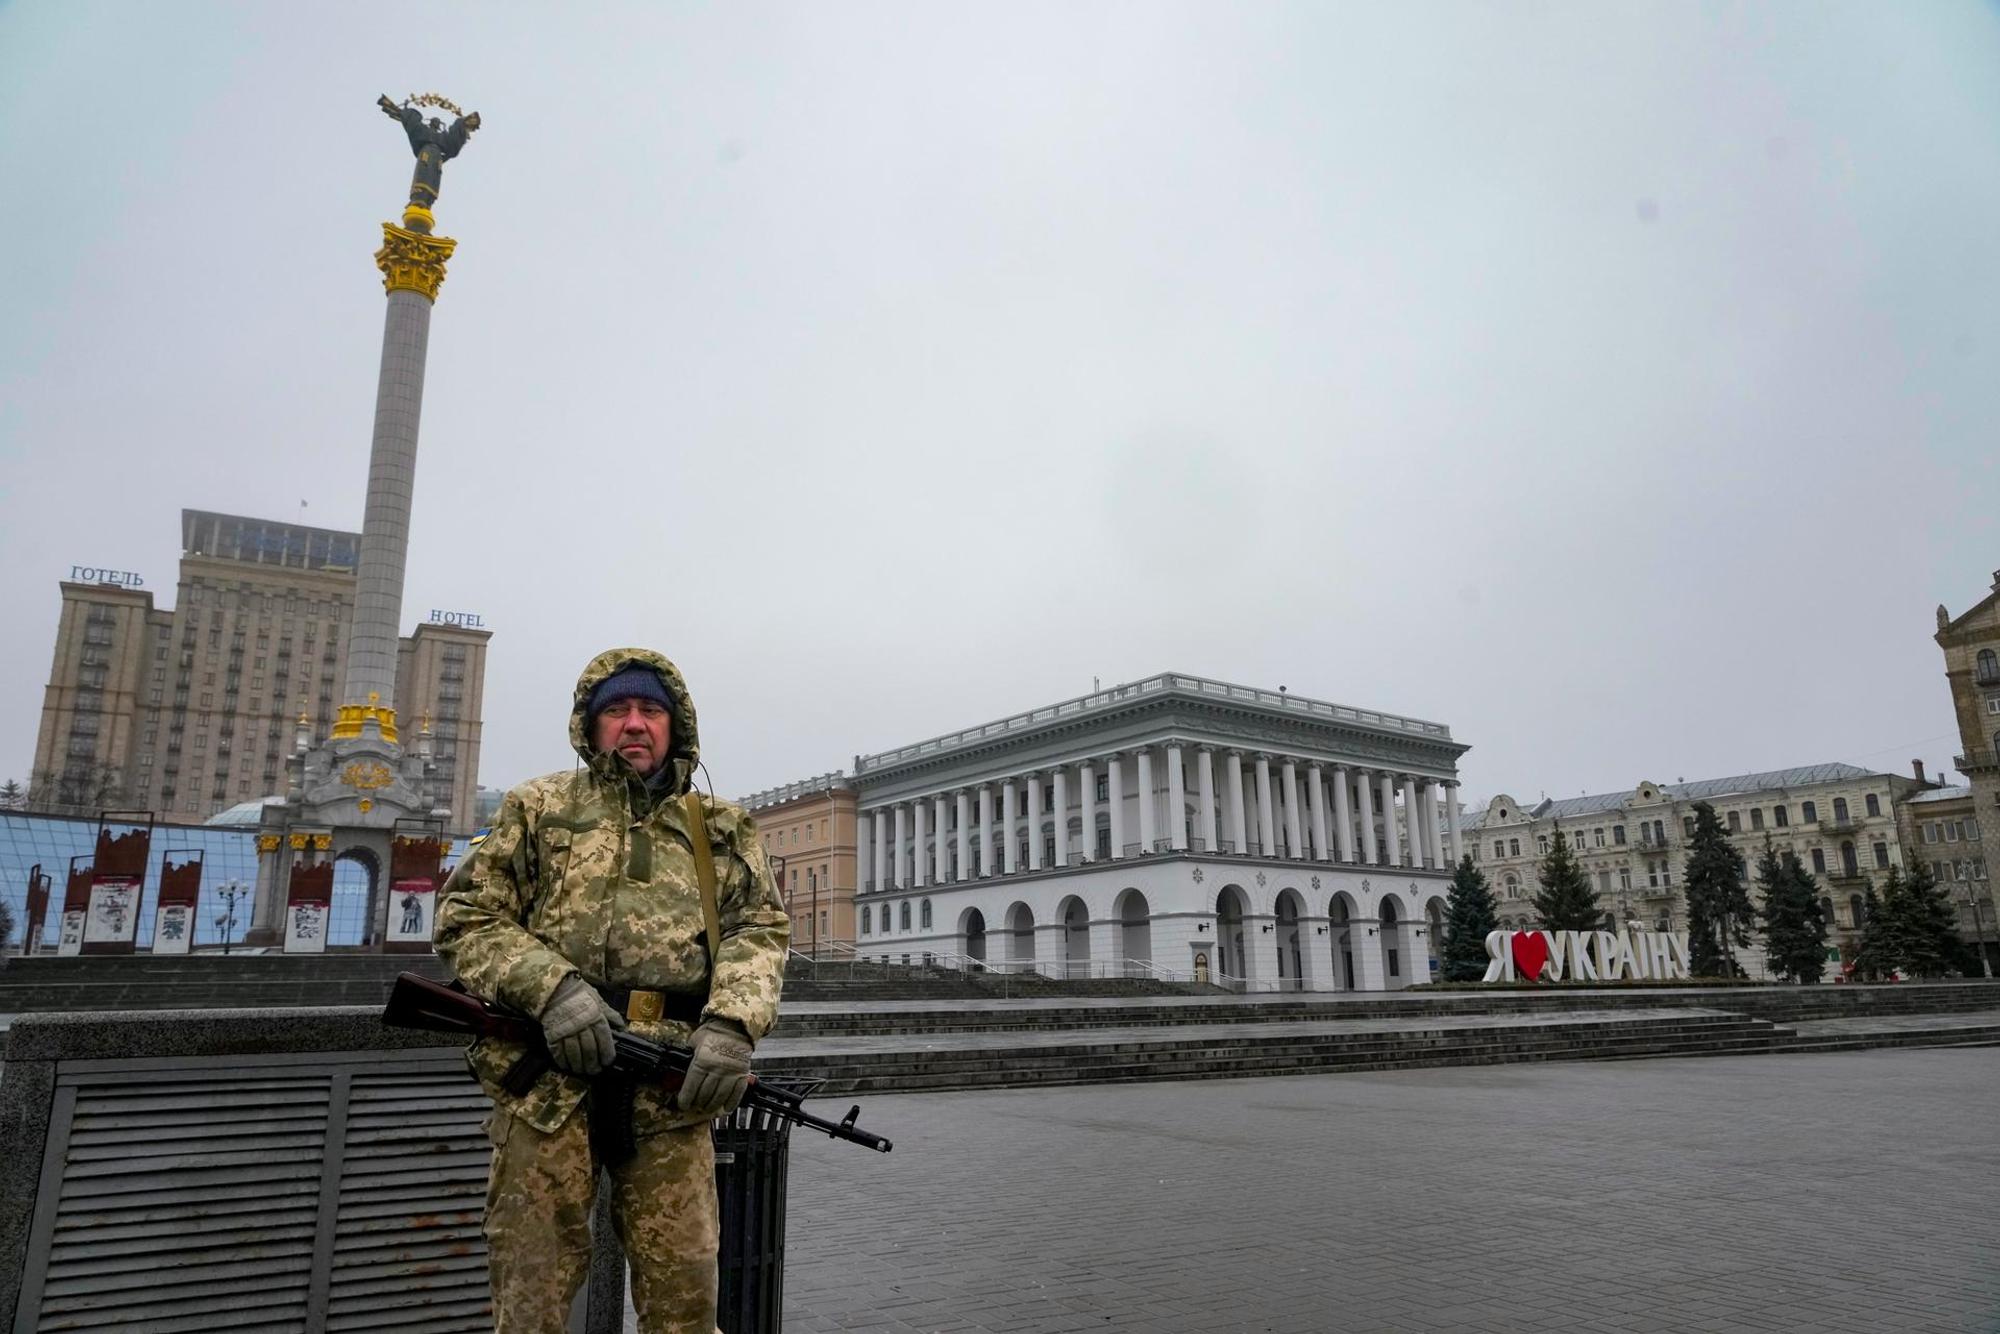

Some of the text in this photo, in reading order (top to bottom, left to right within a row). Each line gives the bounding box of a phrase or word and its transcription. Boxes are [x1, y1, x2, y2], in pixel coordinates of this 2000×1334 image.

[71, 566, 144, 586] ГОТЕЛЬ
[431, 609, 485, 627] HOTEL
[1482, 930, 1515, 982] Я
